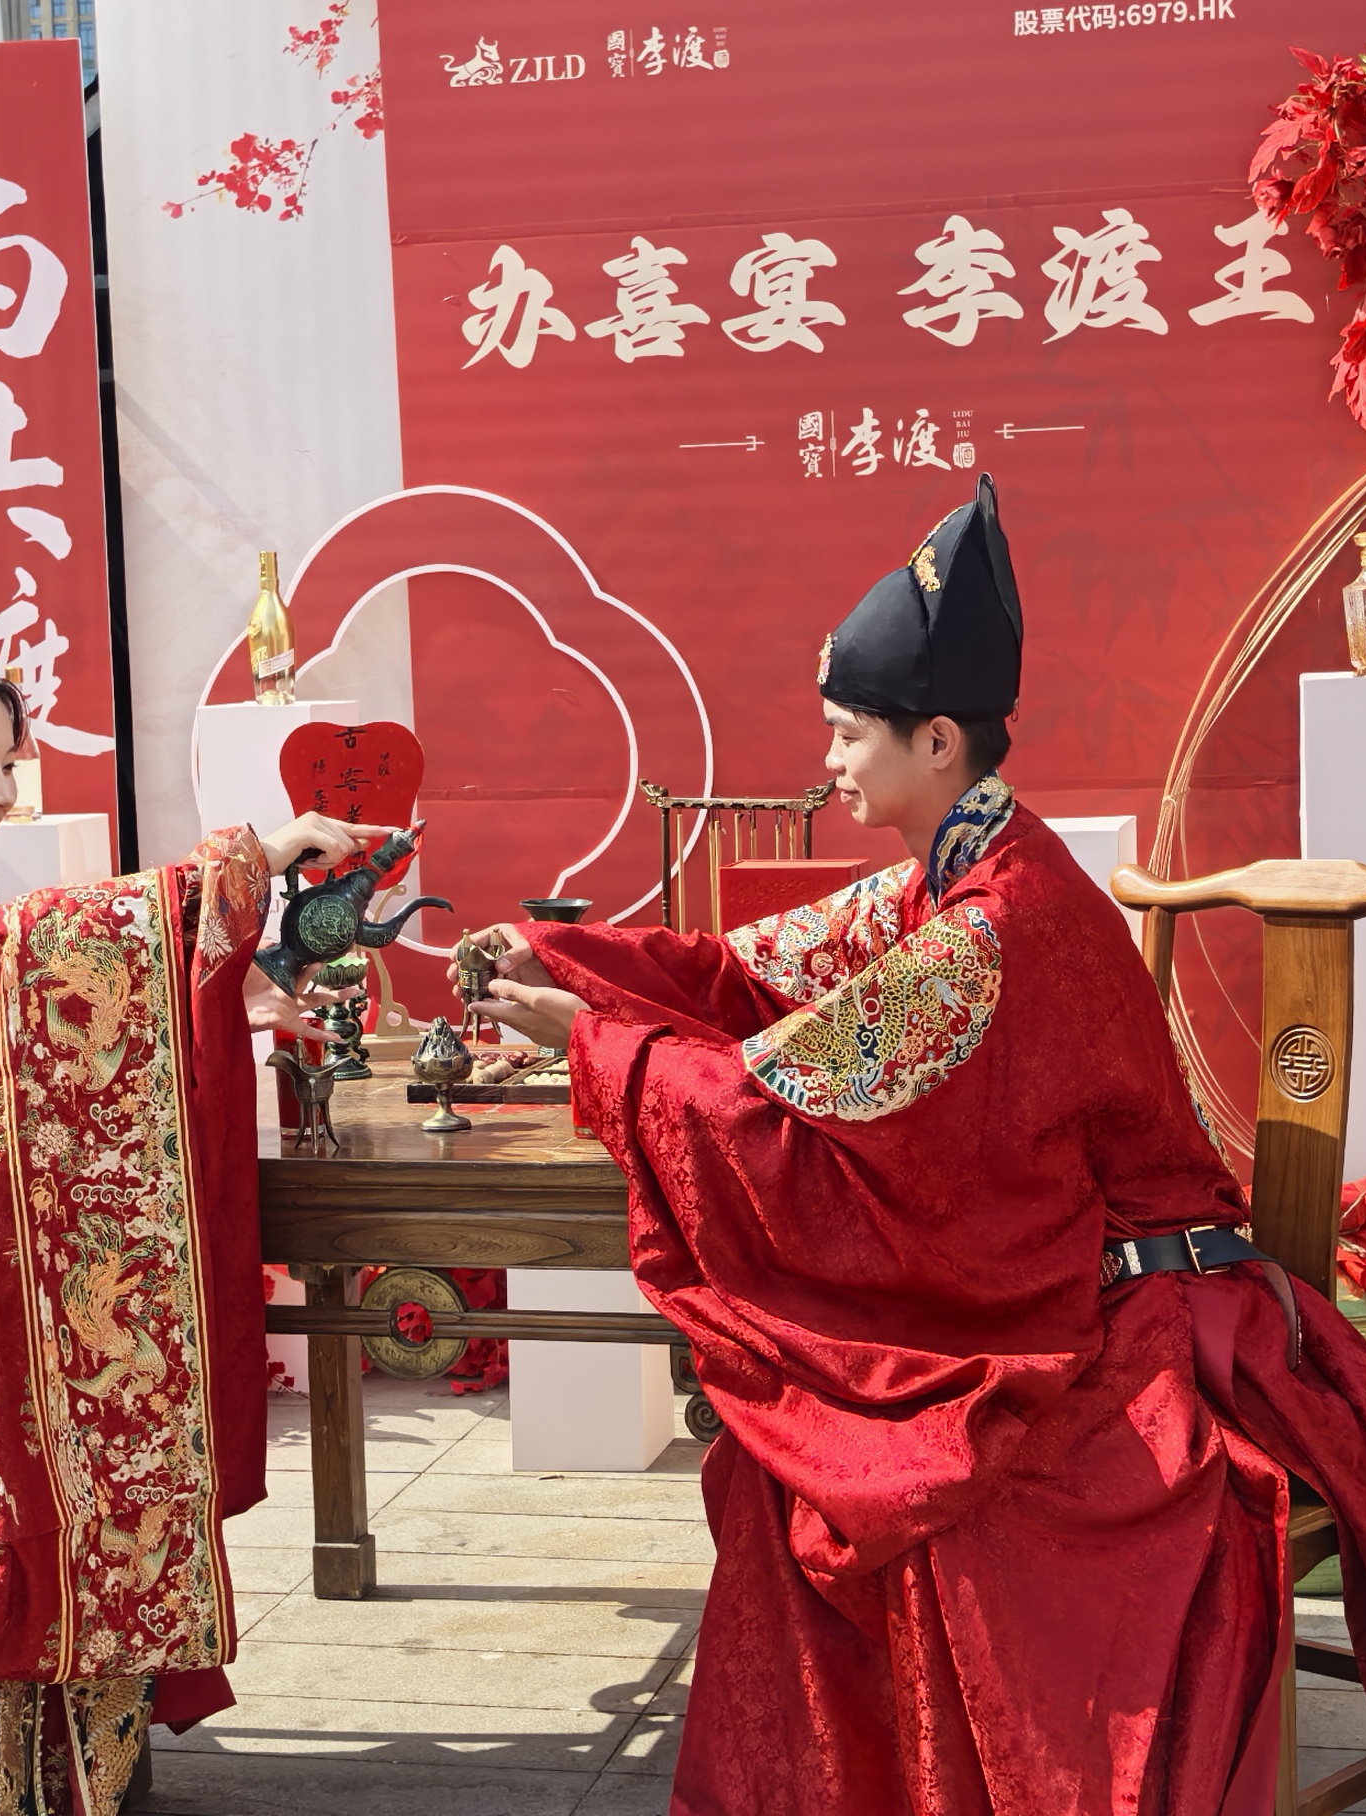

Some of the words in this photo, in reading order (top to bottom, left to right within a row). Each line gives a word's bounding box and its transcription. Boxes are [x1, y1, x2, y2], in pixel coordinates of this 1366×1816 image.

[1013, 0, 1236, 36] 股票代码:6979.HK
[509, 54, 586, 84] ZJLD
[637, 26, 714, 76] 李渡
[461, 232, 847, 371] 办喜宴
[896, 208, 1316, 346] 李渡王
[841, 407, 952, 476] 李渡
